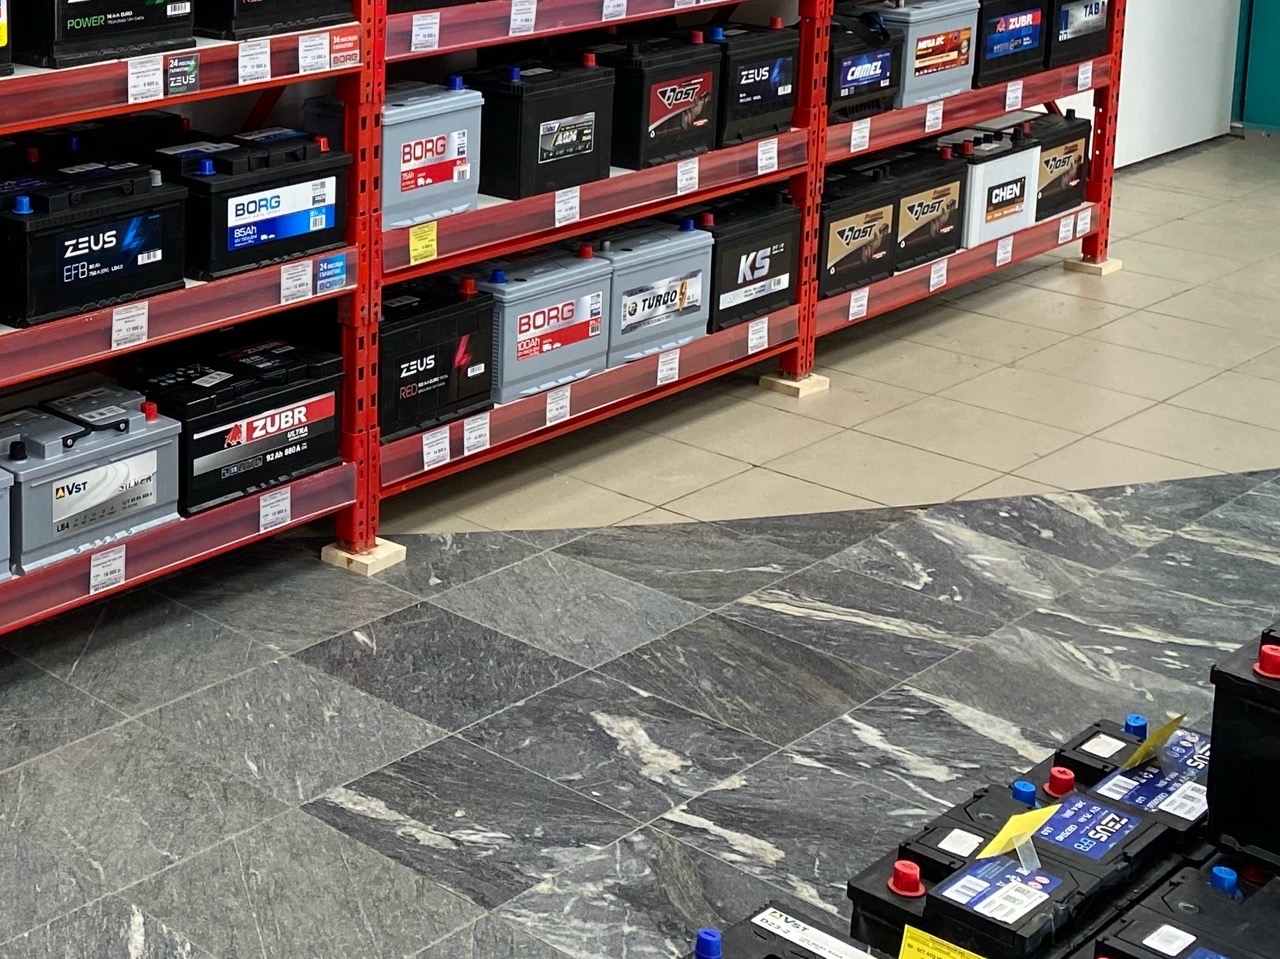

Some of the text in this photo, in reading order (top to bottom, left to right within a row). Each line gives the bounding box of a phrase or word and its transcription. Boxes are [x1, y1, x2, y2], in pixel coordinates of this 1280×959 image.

[1084, 4, 1100, 18] TAB
[67, 15, 105, 30] POWER
[1009, 13, 1033, 31] ZUBR
[333, 53, 358, 65] BORG
[740, 67, 769, 85] ZEUS
[846, 60, 882, 81] CAMEL
[402, 136, 447, 163] BORG
[402, 171, 414, 180] 75Ah
[992, 182, 1020, 204] CHEN
[235, 195, 281, 217] BORG
[234, 225, 257, 238] 85Ah
[64, 231, 117, 258] ZEUS
[64, 262, 88, 282] EFB
[738, 247, 771, 284] KS
[641, 290, 678, 312] TURBO
[518, 302, 575, 334] BORG
[400, 354, 435, 378] ZEUS
[400, 382, 417, 400] RED
[253, 406, 308, 435] ZUBR
[287, 426, 308, 438] ULTRA
[66, 480, 87, 495] VST
[57, 521, 70, 533] LB4
[1087, 813, 1129, 842] ZEUS
[759, 917, 791, 935] D23-2
[782, 916, 810, 932] VST
